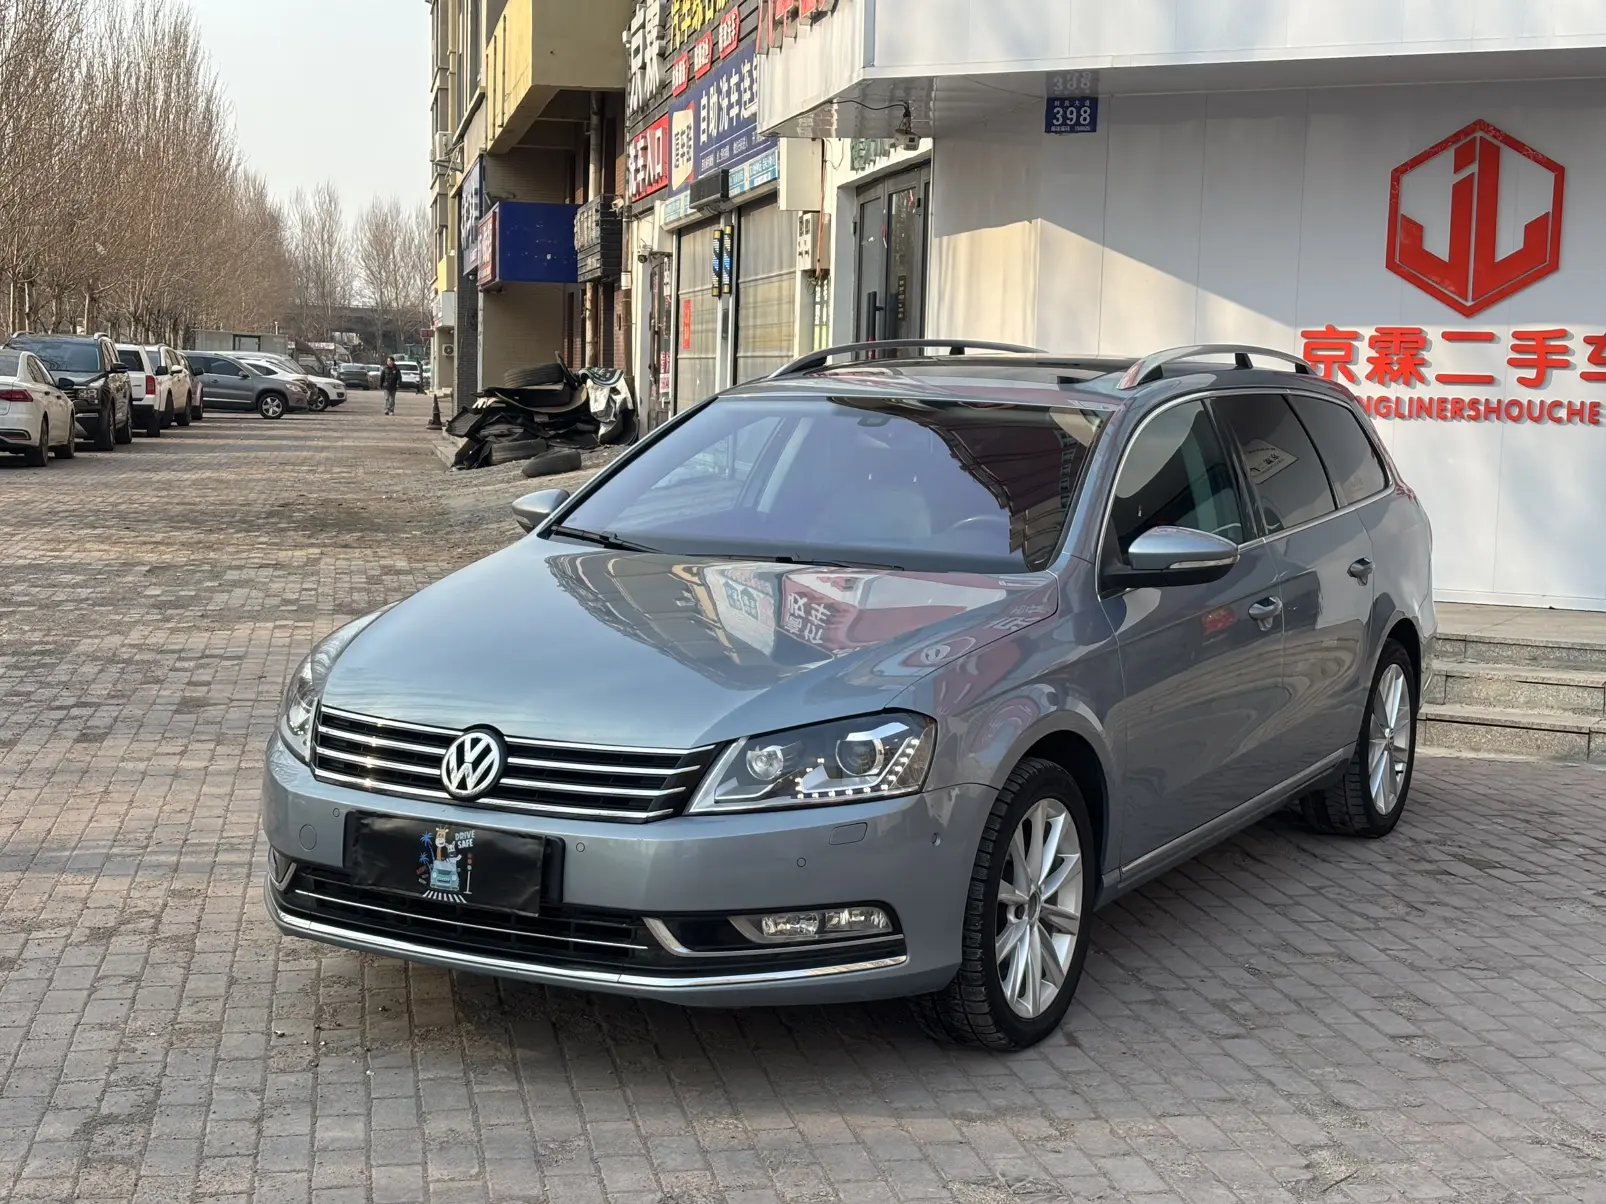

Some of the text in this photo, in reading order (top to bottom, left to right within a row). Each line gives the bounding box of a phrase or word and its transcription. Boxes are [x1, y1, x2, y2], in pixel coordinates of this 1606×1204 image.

[1052, 106, 1091, 125] 398
[455, 830, 476, 841] DRIVE
[457, 839, 474, 849] SAFE
